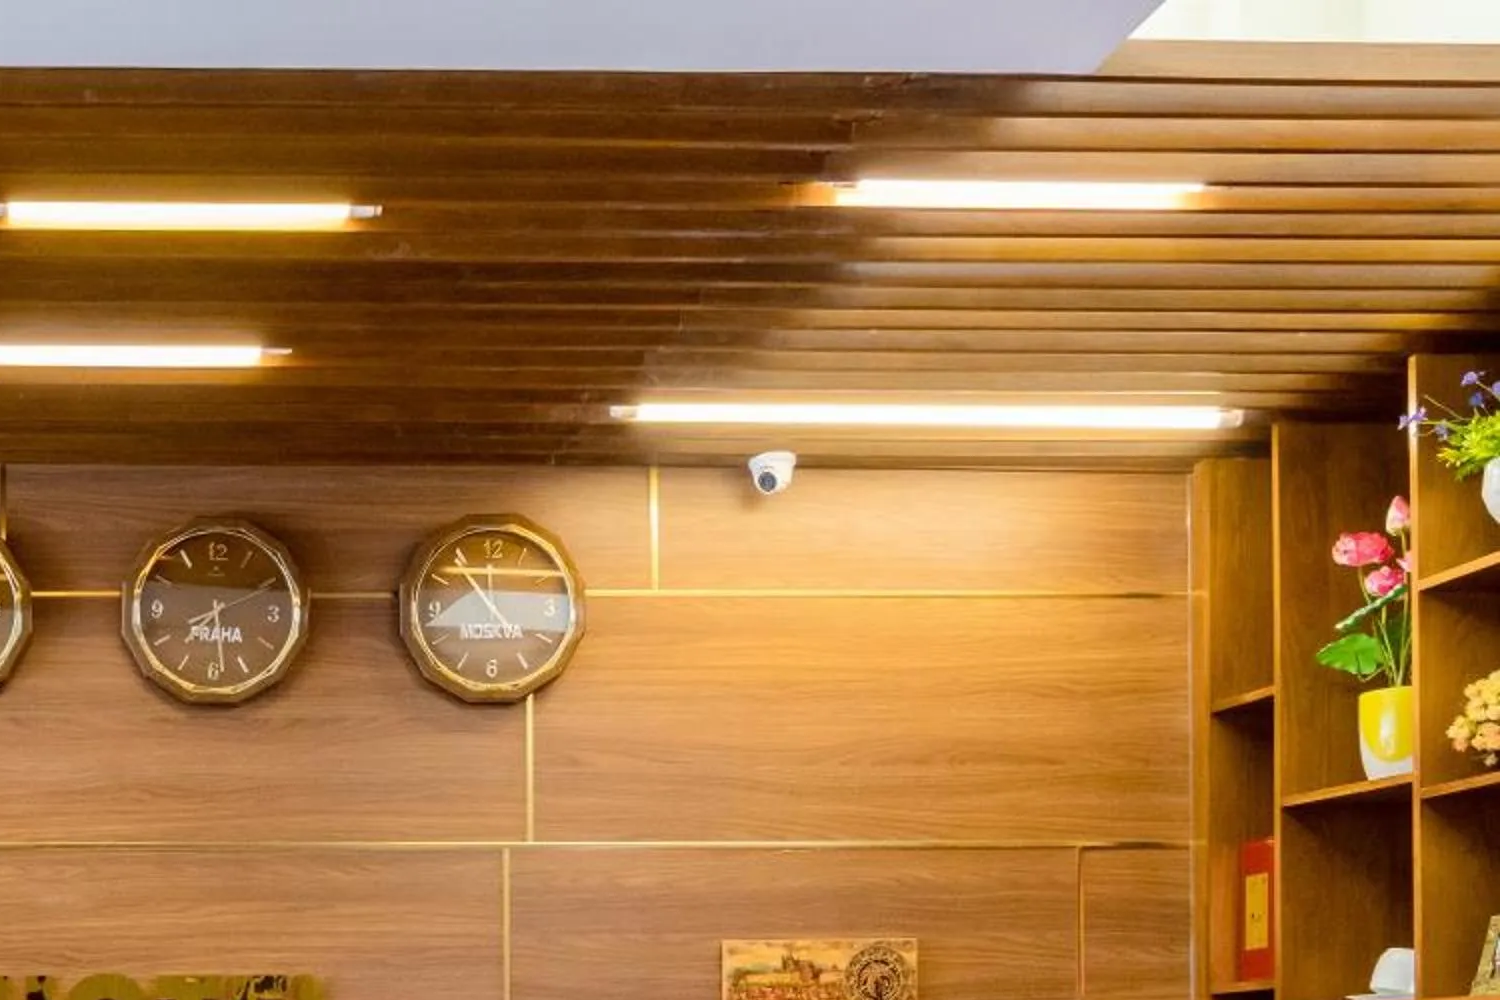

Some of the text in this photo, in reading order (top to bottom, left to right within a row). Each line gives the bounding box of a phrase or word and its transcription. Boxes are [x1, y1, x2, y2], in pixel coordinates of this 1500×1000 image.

[209, 542, 228, 561] 12
[484, 540, 503, 559] 12
[151, 601, 164, 618] 9
[267, 606, 280, 622] 3
[428, 601, 441, 618] 9
[544, 600, 556, 616] 3
[190, 627, 242, 642] PRAHA
[460, 623, 524, 640] MOSKVA
[207, 662, 220, 680] 6
